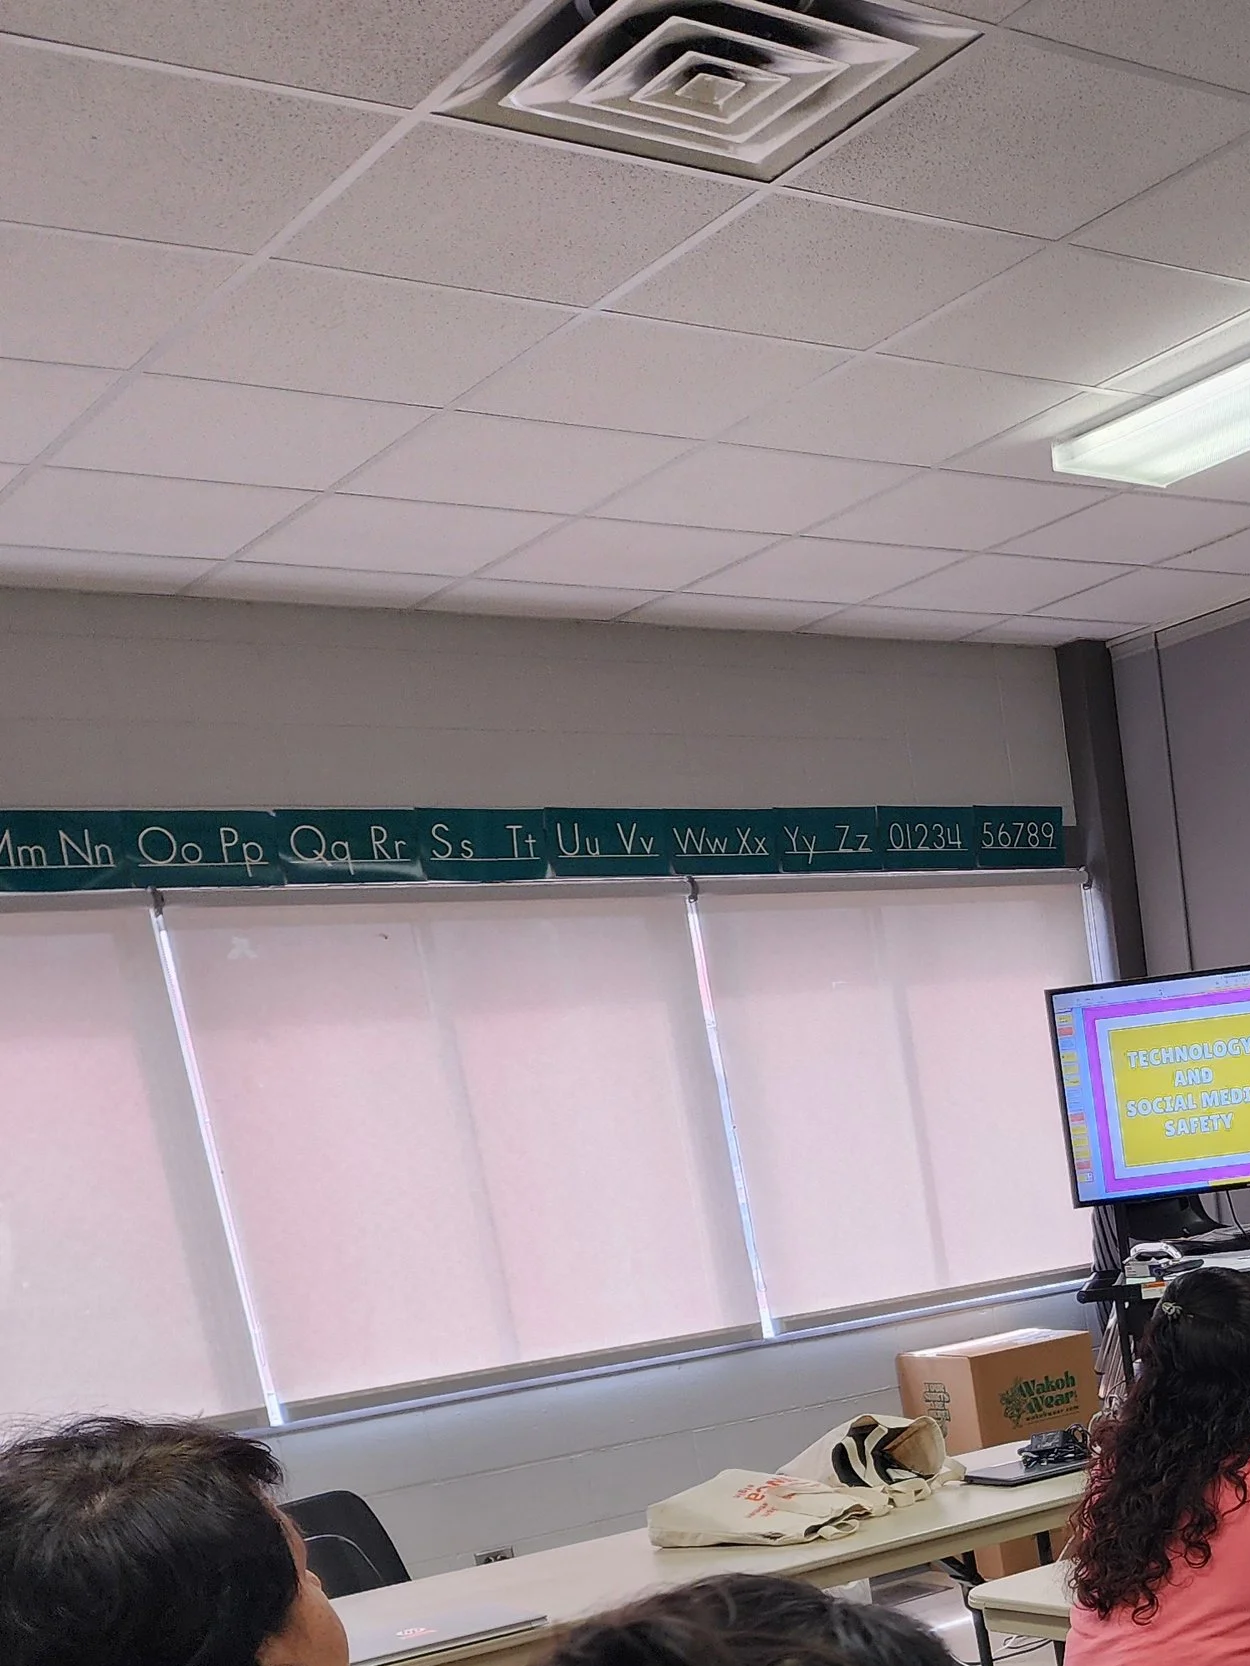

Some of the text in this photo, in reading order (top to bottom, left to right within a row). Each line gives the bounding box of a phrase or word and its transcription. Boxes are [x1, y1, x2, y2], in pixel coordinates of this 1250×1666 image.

[59, 829, 112, 866] Nn
[138, 826, 202, 865] Oo
[219, 827, 264, 877] Pp
[290, 824, 354, 875] Qq
[371, 826, 405, 861] Rr
[431, 823, 474, 860] Ss
[506, 825, 536, 856] Tt
[555, 822, 601, 856] Uu
[616, 822, 655, 856] Vv
[672, 827, 727, 855] Ww
[736, 826, 769, 855] Xx
[783, 826, 817, 865] Yy
[834, 825, 869, 853] Zz
[888, 823, 962, 851] 01234
[981, 821, 1055, 850] 56789
[1174, 1067, 1214, 1087] AND
[1126, 1093, 1198, 1118] SOCIAL
[1165, 1112, 1234, 1138] SAFETY
[1017, 1370, 1076, 1398] Wakoh
[1026, 1390, 1074, 1414] Wear
